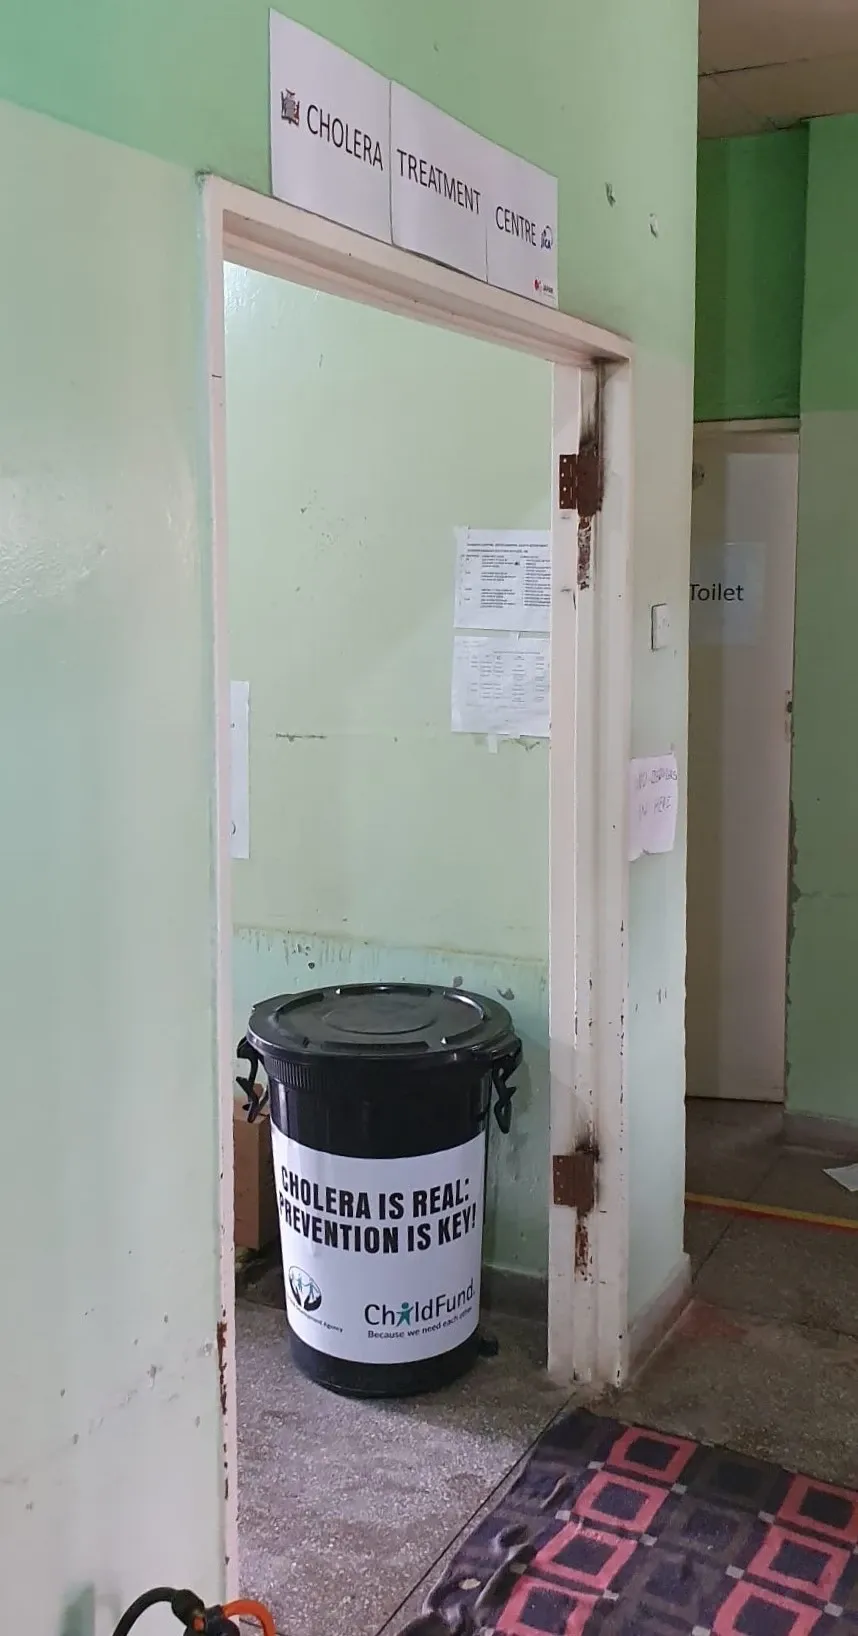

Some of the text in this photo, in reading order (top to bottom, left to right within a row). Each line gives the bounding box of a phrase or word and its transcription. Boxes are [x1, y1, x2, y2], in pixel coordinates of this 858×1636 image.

[306, 104, 537, 247] CHOLERA TREATMENT CENTRE
[689, 582, 744, 602] Toilet
[281, 1164, 470, 1221] CHOLERA IS REAL:
[279, 1191, 477, 1255] PREVENTION IS KEY!
[367, 1329, 405, 1339] Because
[407, 1328, 421, 1337] we
[422, 1321, 442, 1334] need
[442, 1314, 459, 1328] each
